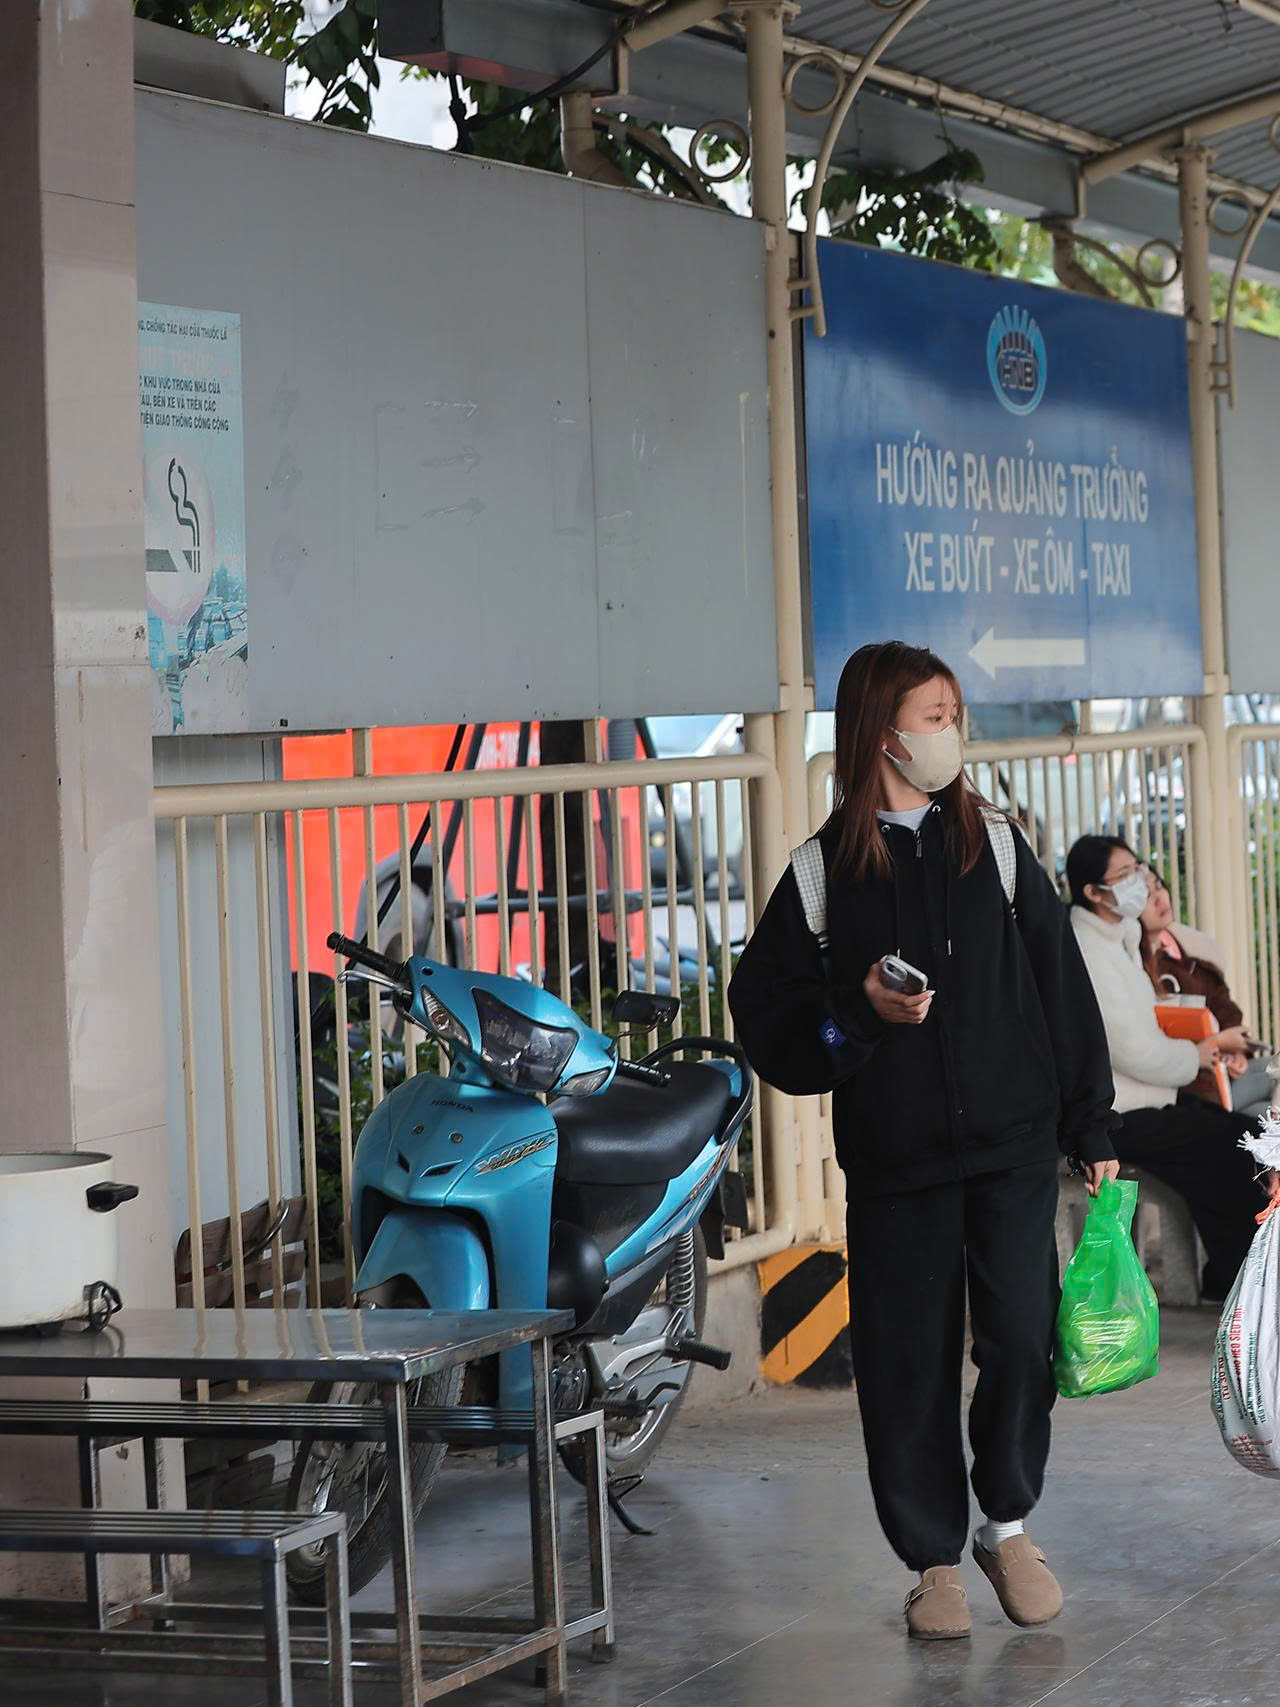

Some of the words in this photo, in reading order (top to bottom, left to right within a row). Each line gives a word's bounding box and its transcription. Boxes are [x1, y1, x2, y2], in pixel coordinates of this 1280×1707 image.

[144, 376, 157, 388] KHU
[159, 376, 172, 393] VỰC
[172, 378, 193, 392] TRONG
[194, 378, 207, 393] NHÀ
[208, 377, 221, 394] CỦA
[167, 395, 176, 408] XE
[187, 395, 203, 411] TRÊN
[204, 396, 217, 412] CÁC
[155, 413, 170, 426] GIAO
[172, 412, 193, 428] THÔNG
[212, 416, 229, 434] CỘNG
[876, 429, 958, 509] HƯỚNG
[963, 452, 992, 511] RA
[997, 439, 1067, 517] QUẢNG
[904, 531, 935, 592] XE
[940, 518, 994, 592] BUÝT
[1000, 565, 1009, 576] -
[1014, 537, 1040, 594] XE
[1044, 526, 1075, 595] ÔM
[1091, 543, 1131, 596] TAXI
[431, 1099, 474, 1113] HONDA
[1230, 1343, 1241, 1358] HEO
[1218, 1372, 1227, 1382] 30
